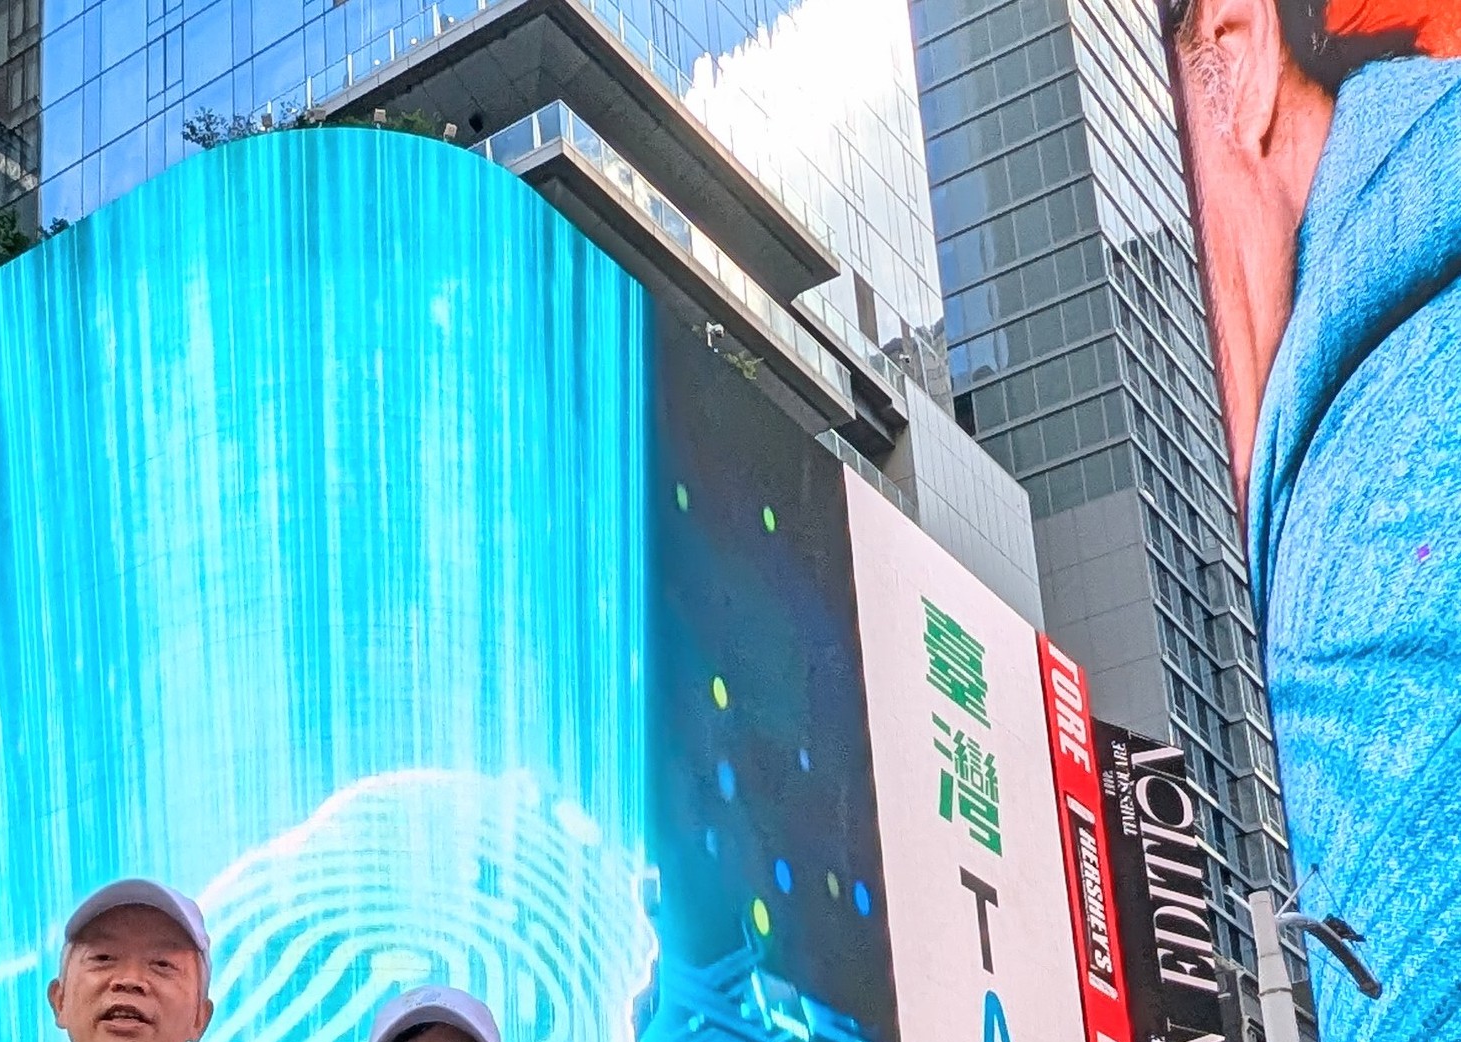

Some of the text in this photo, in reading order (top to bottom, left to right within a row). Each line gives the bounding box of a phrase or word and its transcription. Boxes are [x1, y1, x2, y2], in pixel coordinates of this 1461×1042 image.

[921, 594, 1003, 858] 臺灣
[1046, 641, 1093, 773] TORE
[1111, 740, 1137, 837] TIMES SQUARE
[1129, 731, 1219, 993] EDITION
[1079, 825, 1114, 975] HERSHEY'S
